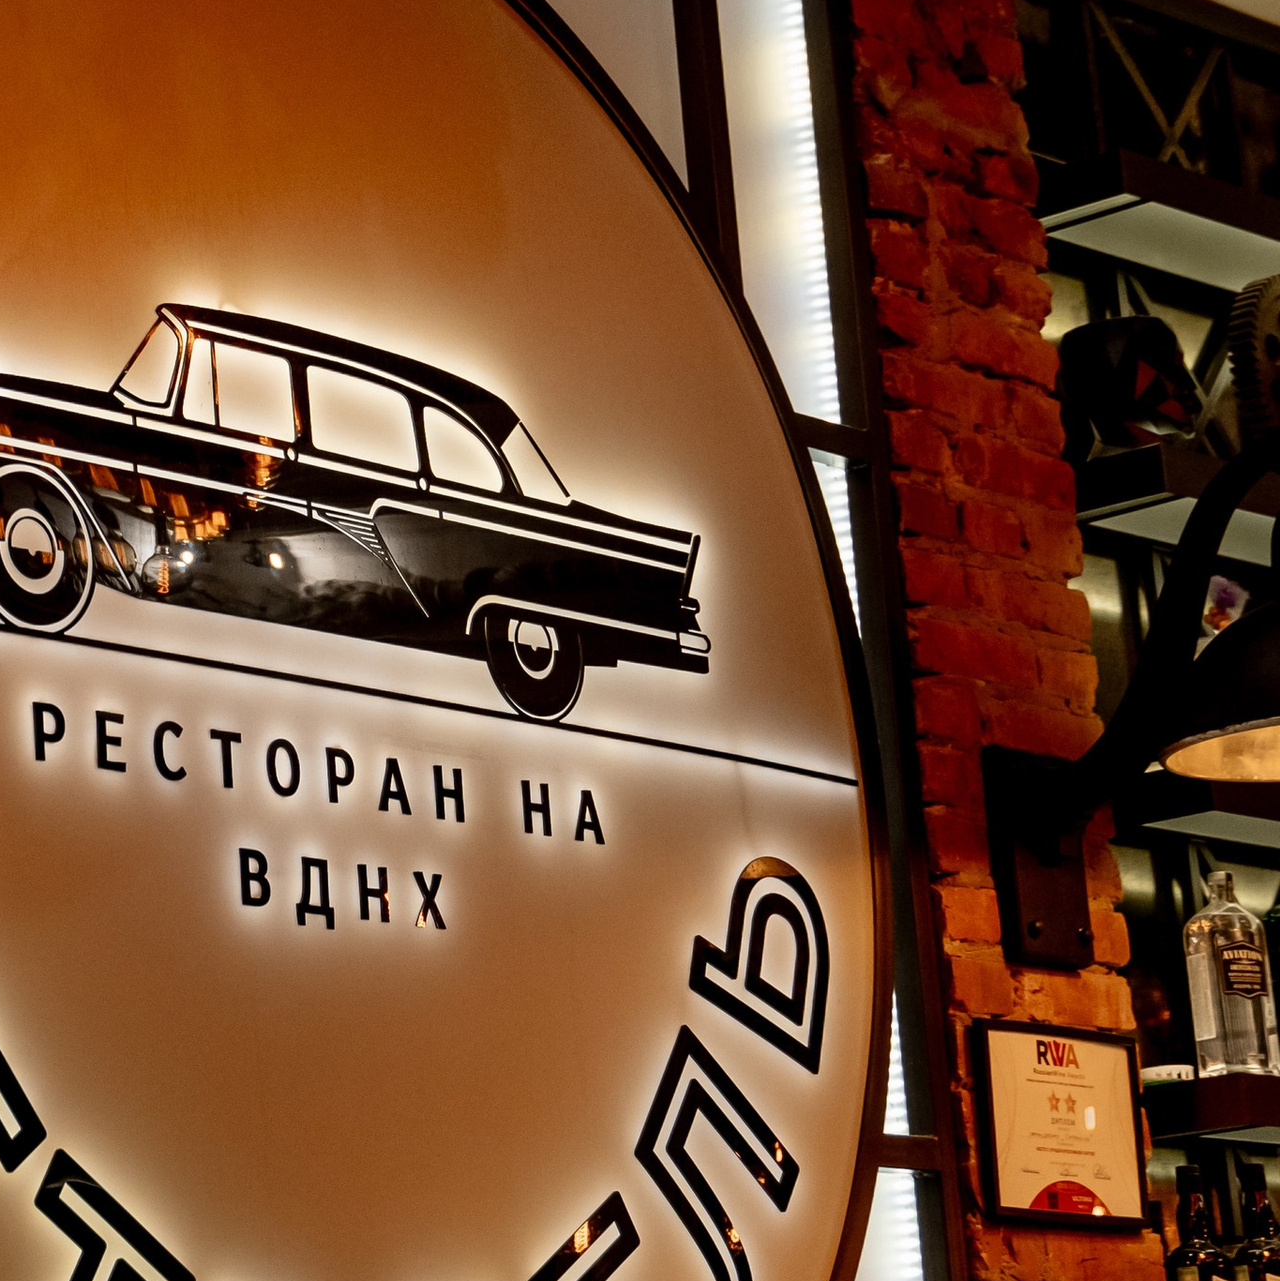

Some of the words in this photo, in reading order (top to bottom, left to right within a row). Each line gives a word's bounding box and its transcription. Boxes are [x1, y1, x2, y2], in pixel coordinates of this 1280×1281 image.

[32, 701, 465, 824] РЕСТОРАН
[520, 777, 605, 846] НА
[238, 846, 447, 930] ВДНХ
